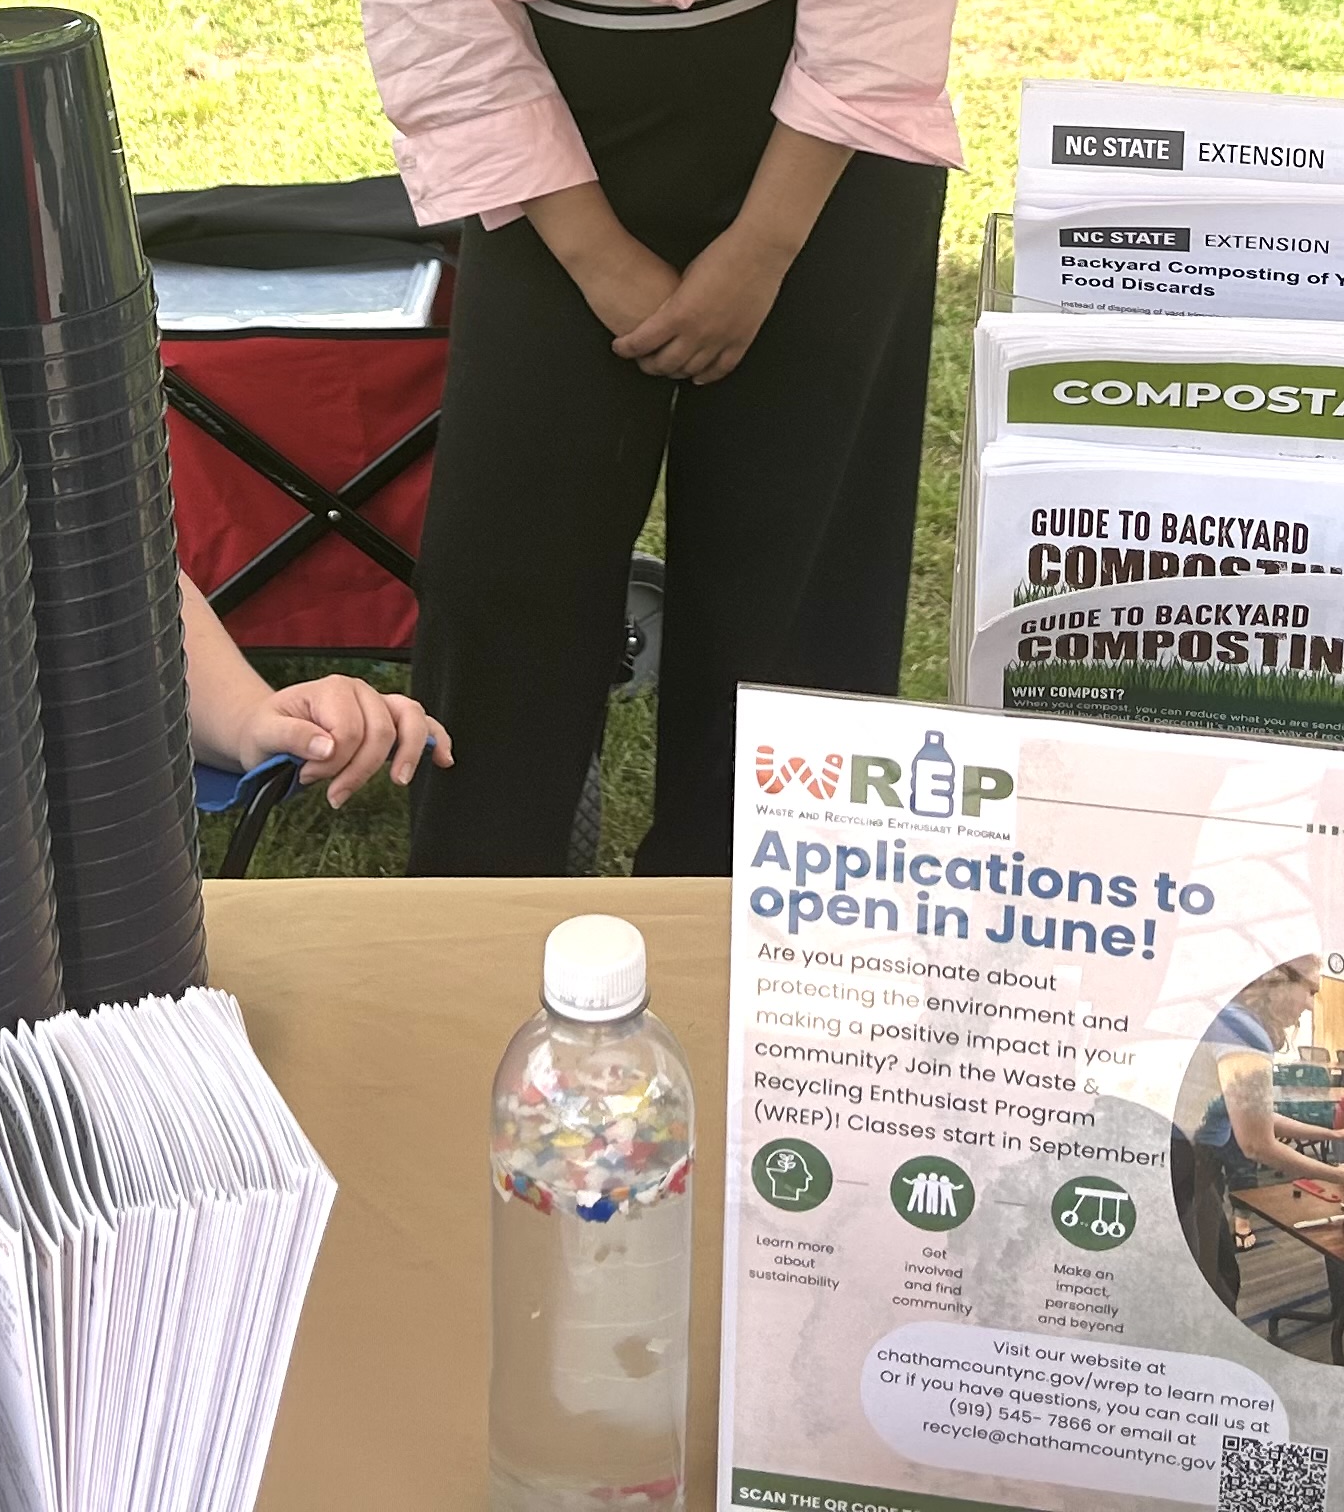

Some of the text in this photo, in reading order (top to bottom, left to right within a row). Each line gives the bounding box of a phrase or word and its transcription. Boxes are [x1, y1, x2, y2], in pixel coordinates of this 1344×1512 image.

[1065, 136, 1324, 169] NC STATE EXTENSION
[1073, 231, 1329, 254] NC STATE EXTENSION
[1062, 256, 1160, 272] Backyard
[1168, 261, 1300, 285] Composting
[1307, 272, 1329, 284] of
[1062, 274, 1215, 296] Food Discards
[1032, 508, 1309, 554] GUIDE TO BACKYARD
[1021, 604, 1309, 634] GUIDE TO BACKYARD
[1012, 686, 1124, 700] WHY COMPOST?
[756, 730, 1014, 818] WREP
[756, 804, 794, 819] WASTE
[799, 811, 819, 821] AND
[750, 829, 1215, 915] Applications to
[750, 886, 1156, 960] open in June!
[758, 943, 1057, 991] Are you passionate about
[757, 978, 1128, 1032] protecting the environment and
[756, 1010, 1136, 1066] making a positive impact in your
[755, 1042, 1100, 1095] community? Join the Waste &
[755, 1071, 1095, 1126] Recycling Enthusiast Program
[754, 1098, 1165, 1167] (WREP)! Classes start in September!
[756, 1235, 834, 1255] Learn more
[774, 1255, 815, 1269] about
[905, 1261, 963, 1279] involved
[1054, 1264, 1114, 1280] Make an
[749, 1268, 840, 1291] sustainability
[904, 1280, 962, 1296] and find
[892, 1296, 973, 1317] community
[1045, 1298, 1119, 1318] personally
[1038, 1315, 1124, 1333] and beyond
[994, 1341, 1166, 1375] Visit our website at
[877, 1348, 1275, 1412] chathamcountync.gov/wrep to learn more!
[880, 1370, 1270, 1434] Or if you have questions, you can call us at
[949, 1397, 992, 1421] (919)
[1048, 1414, 1092, 1432] 7866
[1097, 1423, 1116, 1435] or
[1121, 1426, 1172, 1443] email
[1178, 1433, 1196, 1446] at
[922, 1421, 1216, 1472] recycle@chathamcountync.gov
[739, 1487, 820, 1509] SCAN THE
